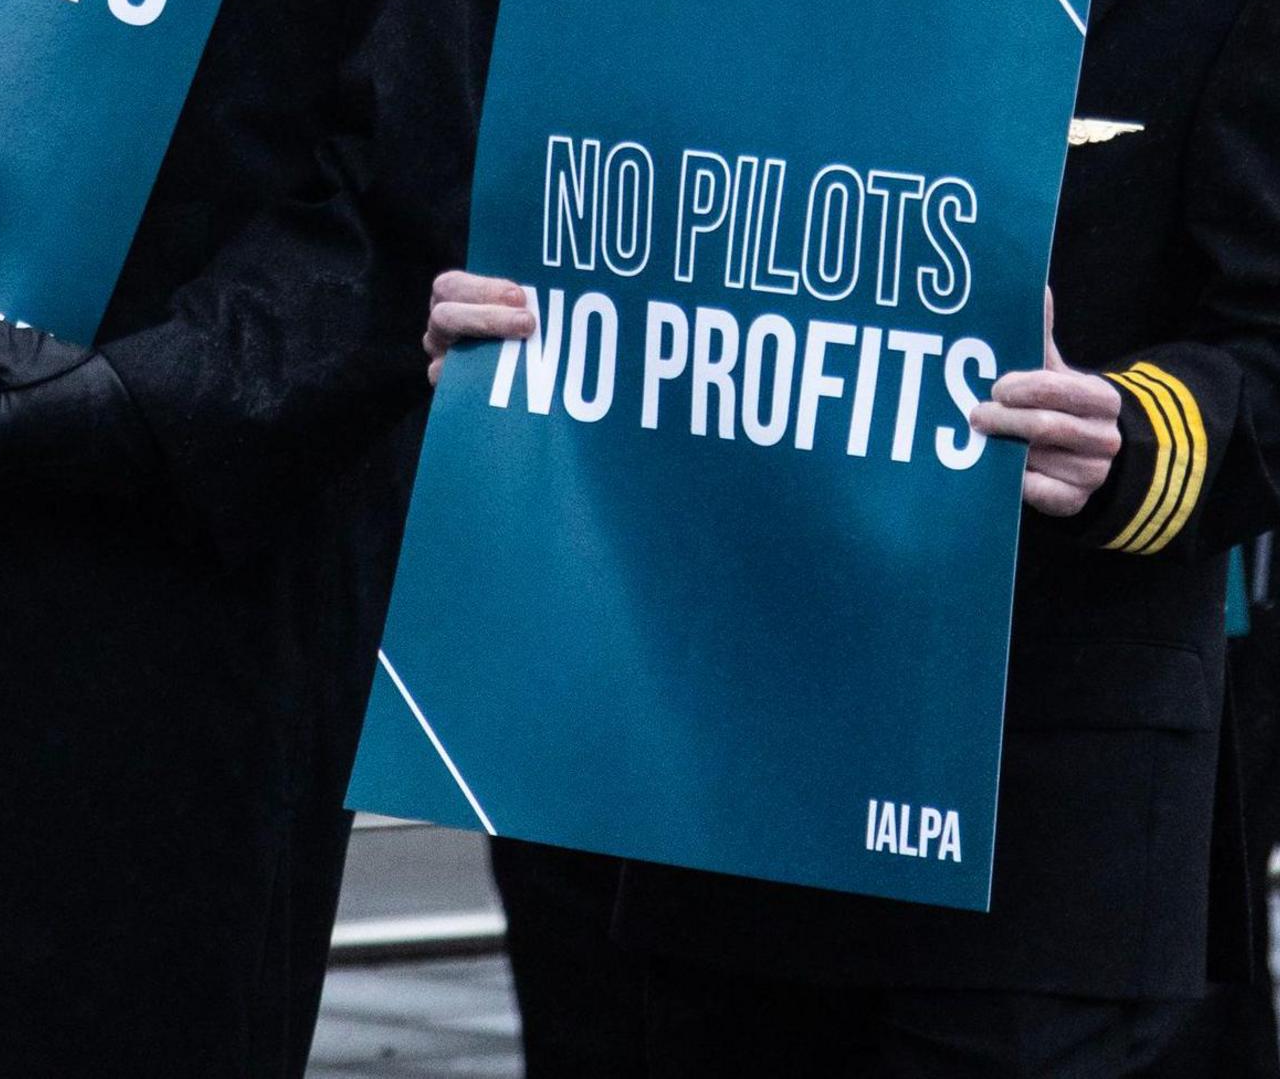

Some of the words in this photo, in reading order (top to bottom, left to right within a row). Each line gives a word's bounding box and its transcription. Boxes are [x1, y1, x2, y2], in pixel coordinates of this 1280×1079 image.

[543, 135, 654, 276] NO
[674, 149, 978, 315] PILOTS
[489, 285, 619, 422] NO
[641, 300, 998, 470] PROFITS
[866, 799, 962, 862] IALPA
